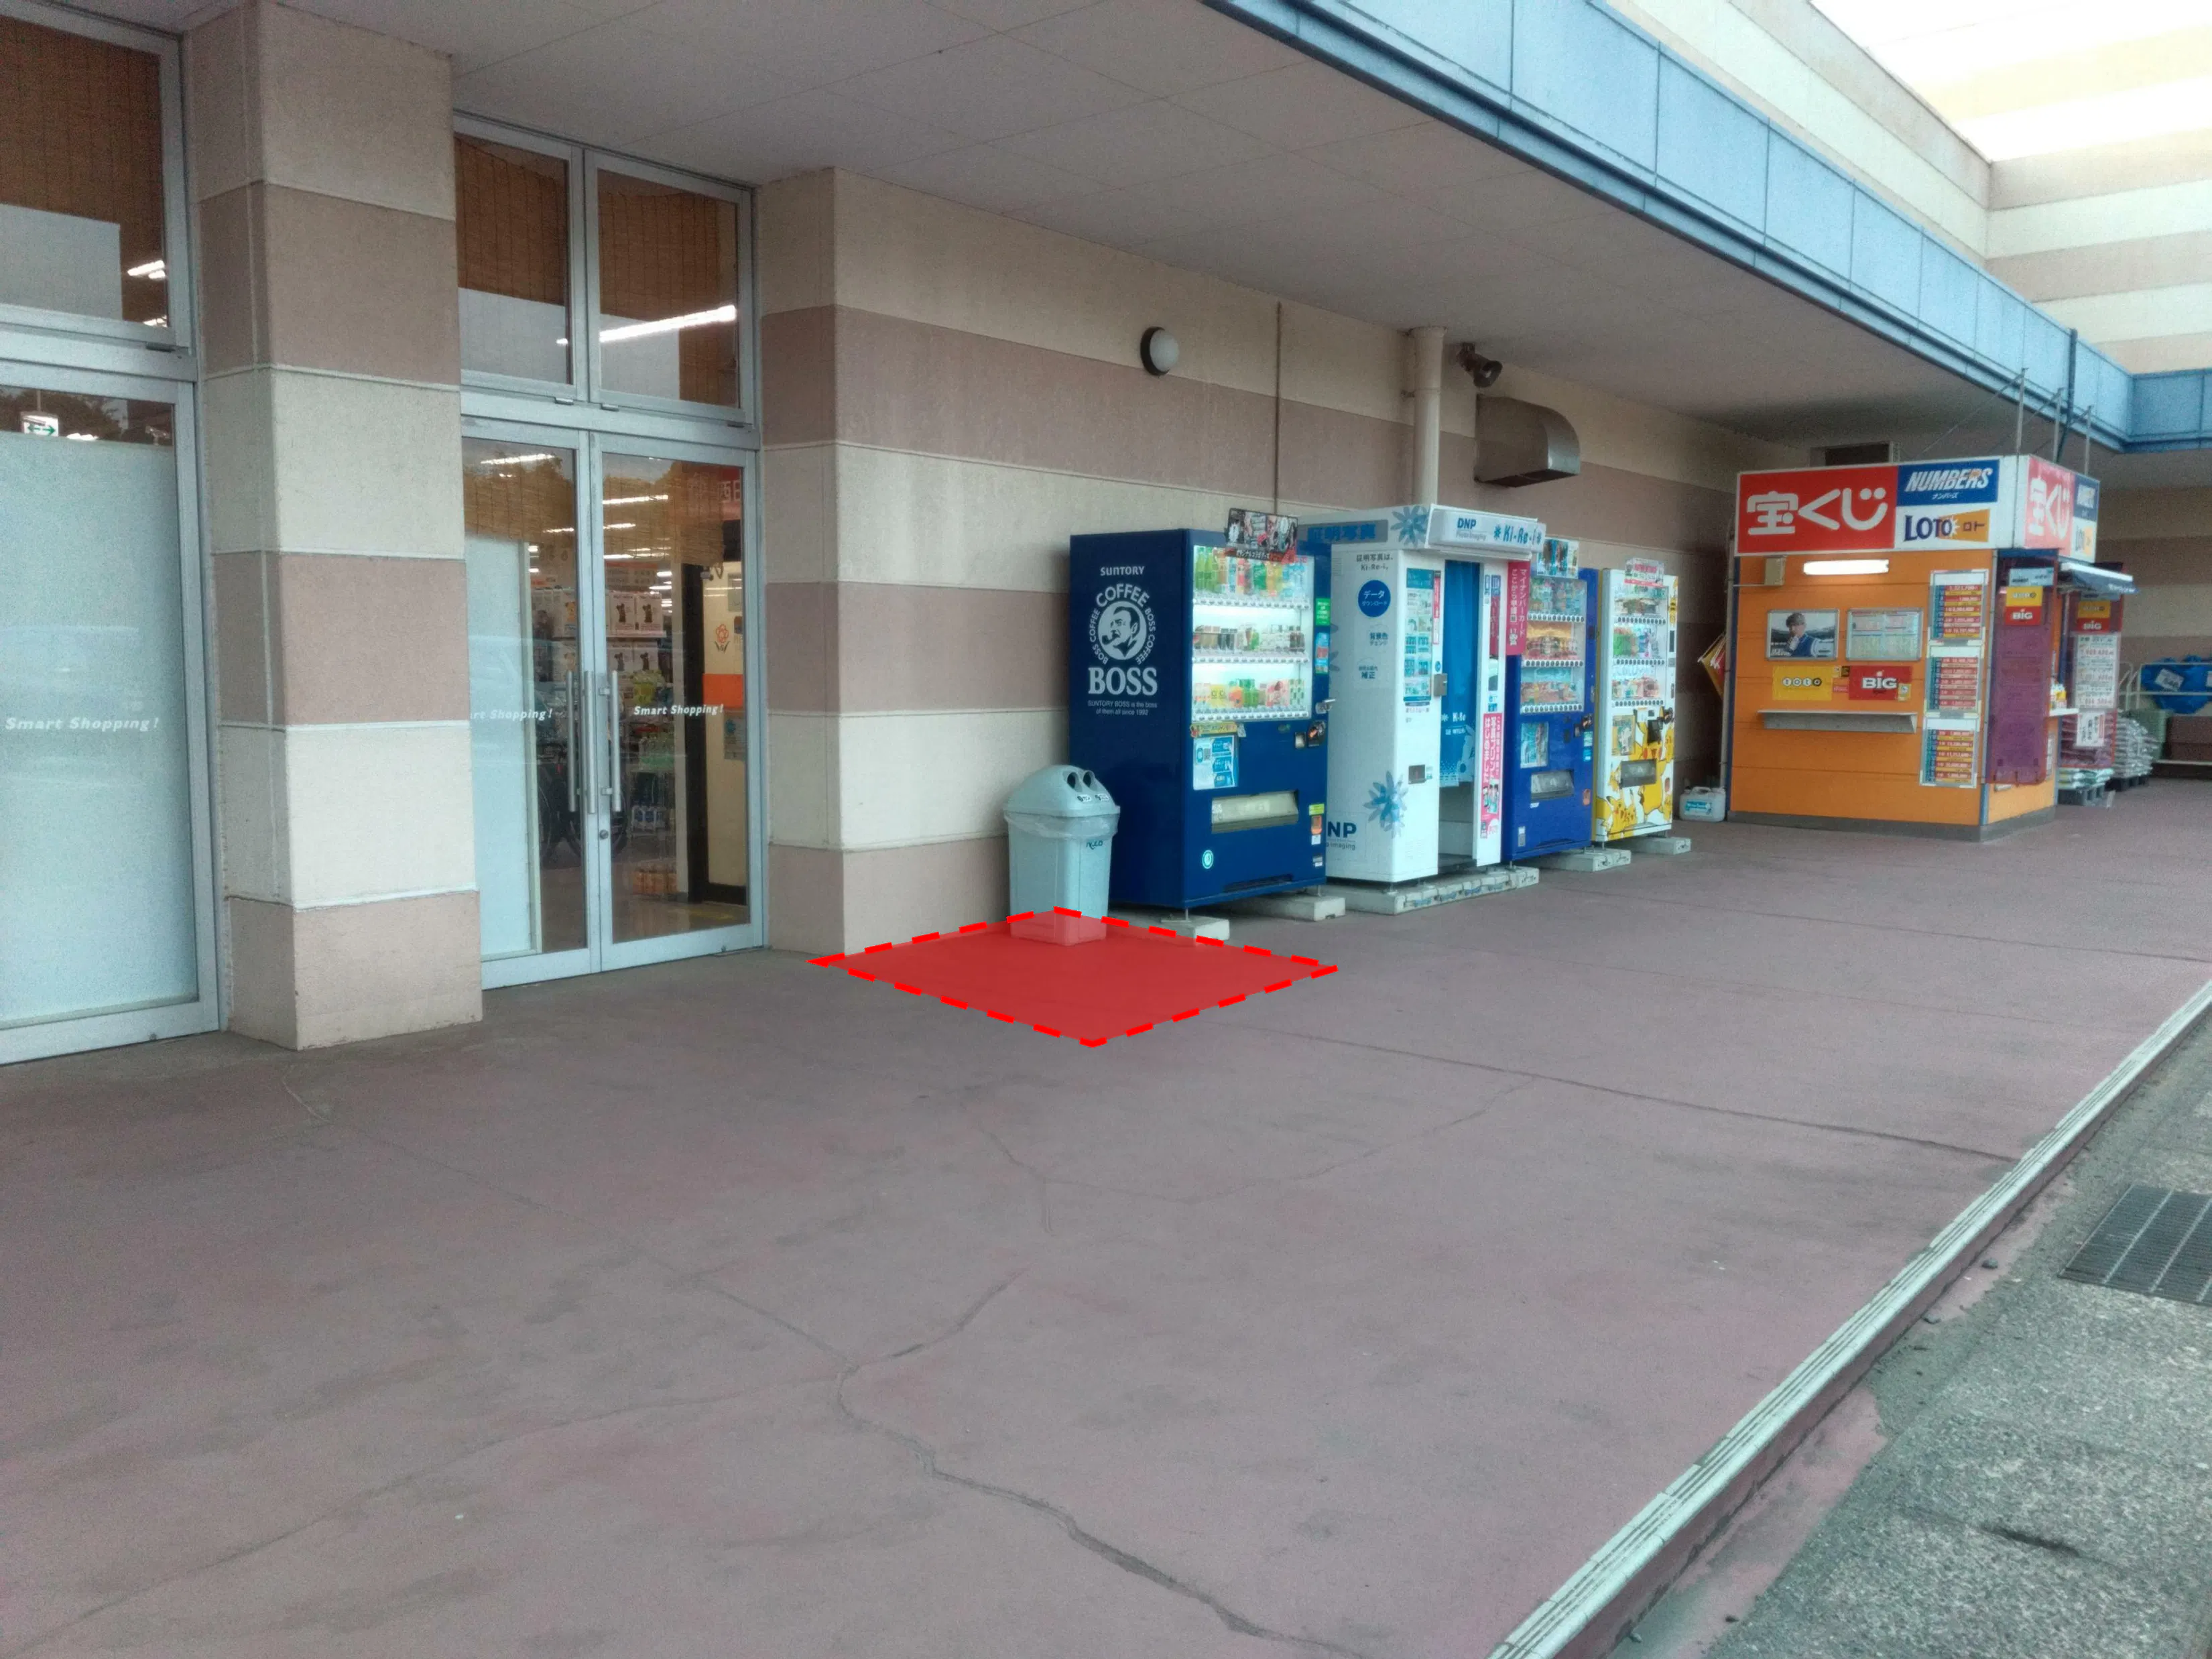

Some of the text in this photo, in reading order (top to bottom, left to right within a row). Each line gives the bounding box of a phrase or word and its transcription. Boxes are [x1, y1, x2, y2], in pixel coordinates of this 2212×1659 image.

[1904, 468, 1993, 492] NUMBERS
[1931, 492, 1959, 500] ナンバーズ
[1747, 487, 1889, 536] 宝くじ
[2028, 477, 2071, 542] 宝くじ
[1457, 518, 1476, 530] DNP
[1904, 515, 1953, 542] LOTO
[1096, 583, 1150, 607] COFFEE
[1363, 590, 1386, 599] データ
[1089, 607, 1109, 665] BOSS COFFEE
[1135, 607, 1156, 666] BOSS COFFEE
[1088, 667, 1158, 696] BOSS
[1782, 677, 1822, 687] toto
[633, 706, 667, 715] Smart
[5, 717, 63, 730] Smart
[1327, 821, 1357, 838] NP
